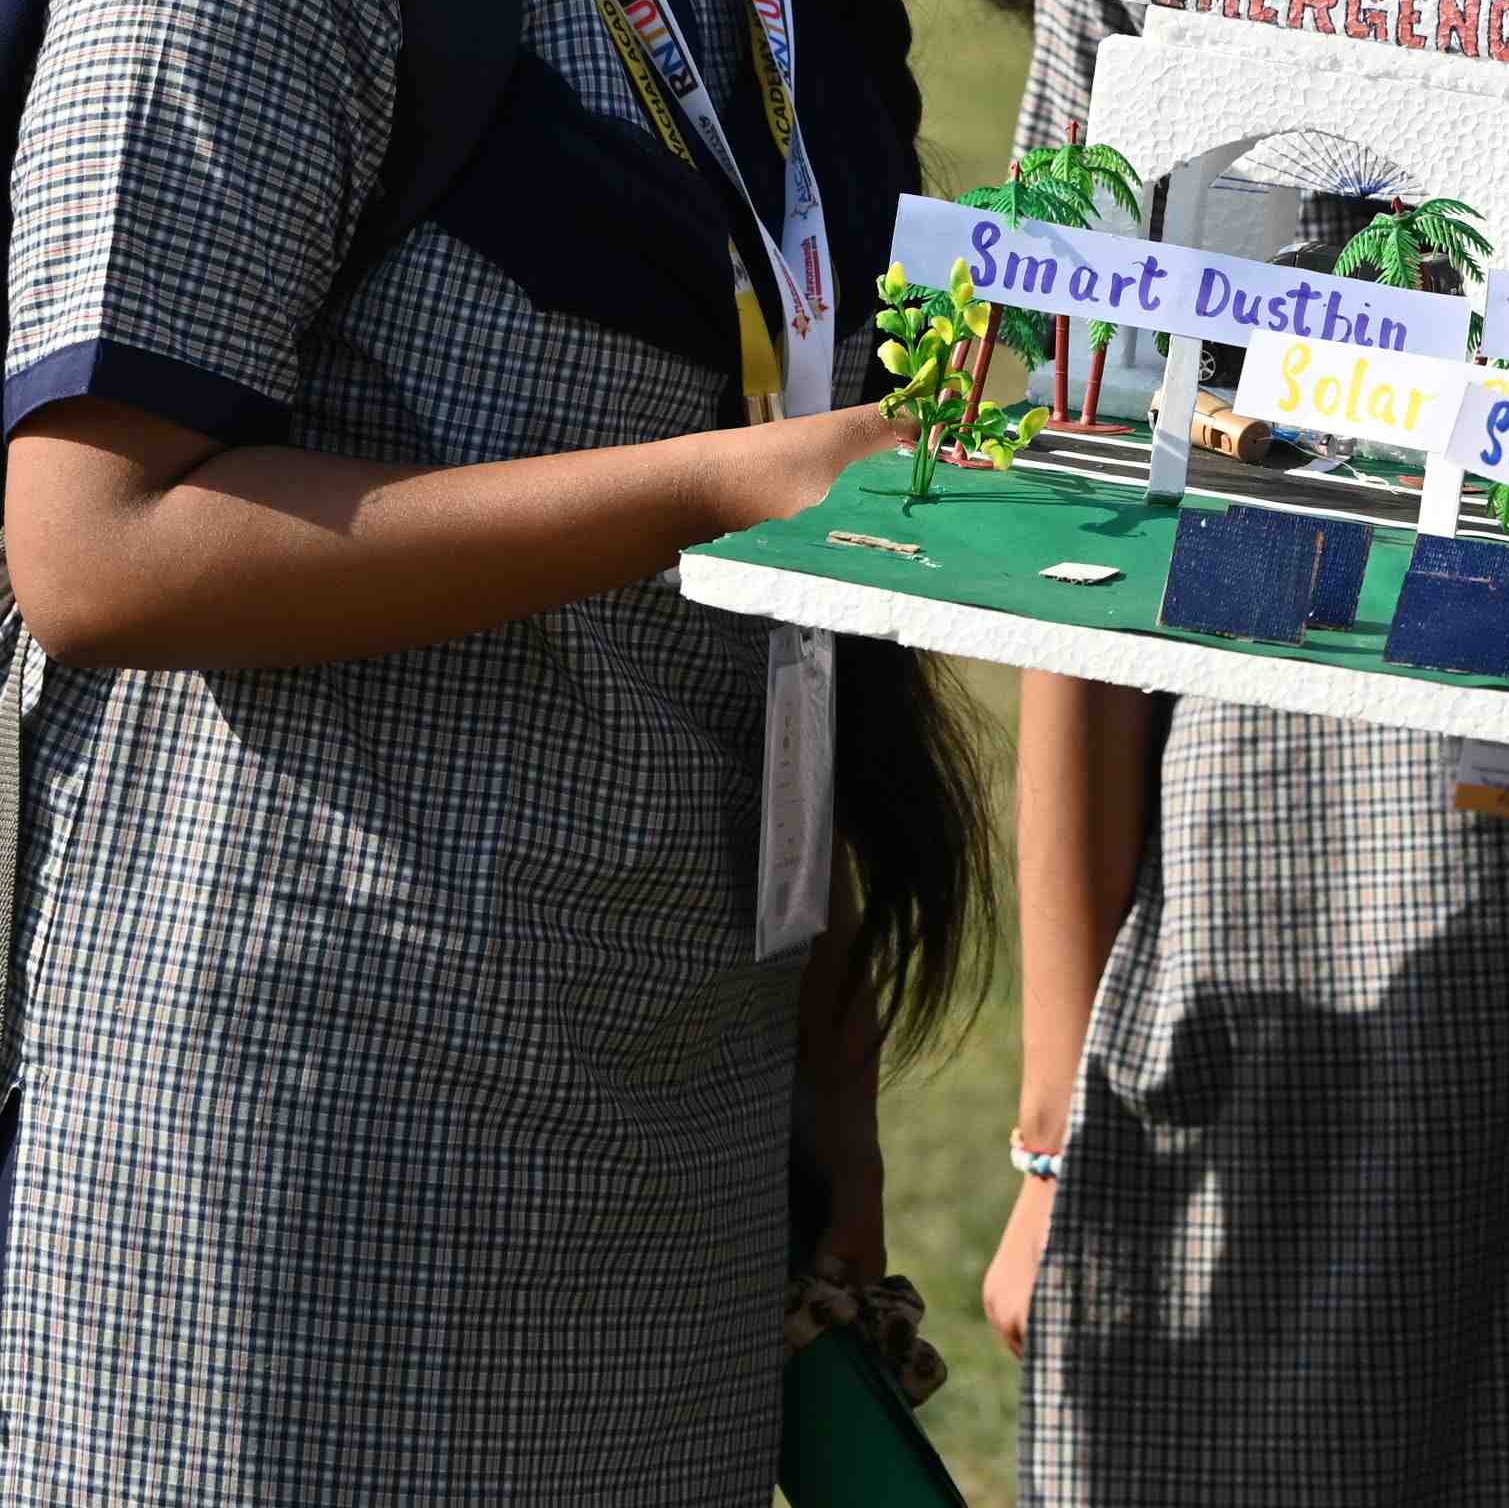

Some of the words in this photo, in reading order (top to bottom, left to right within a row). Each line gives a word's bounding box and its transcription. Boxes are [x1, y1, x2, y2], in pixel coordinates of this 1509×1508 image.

[970, 220, 1168, 311] Smart
[1194, 267, 1408, 352] Dustbin
[1276, 341, 1442, 433] Solar
